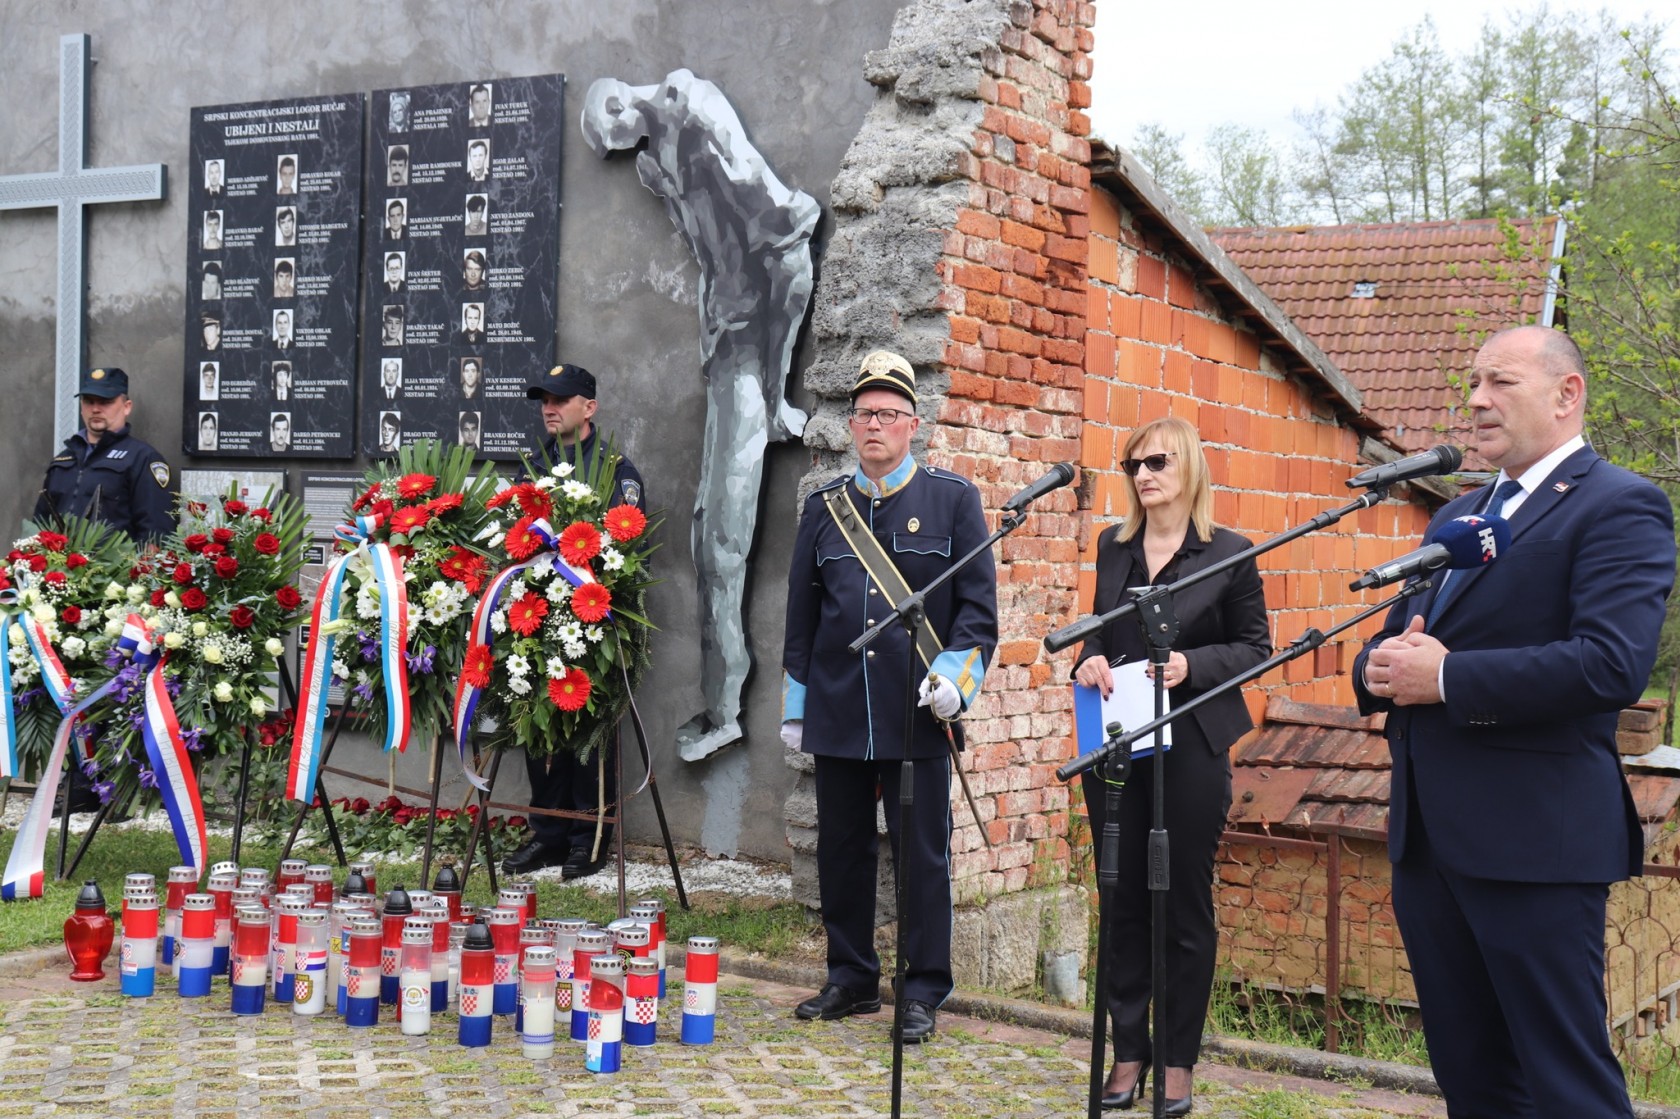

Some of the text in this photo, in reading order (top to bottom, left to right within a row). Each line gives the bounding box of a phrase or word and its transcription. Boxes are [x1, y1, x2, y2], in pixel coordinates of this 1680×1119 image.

[204, 102, 346, 122] SRPSKI KONCENTRACIJSKI LOGOR BUČJE
[225, 120, 319, 138] UBIJENI I NESTALI
[1478, 527, 1497, 562] HRT
